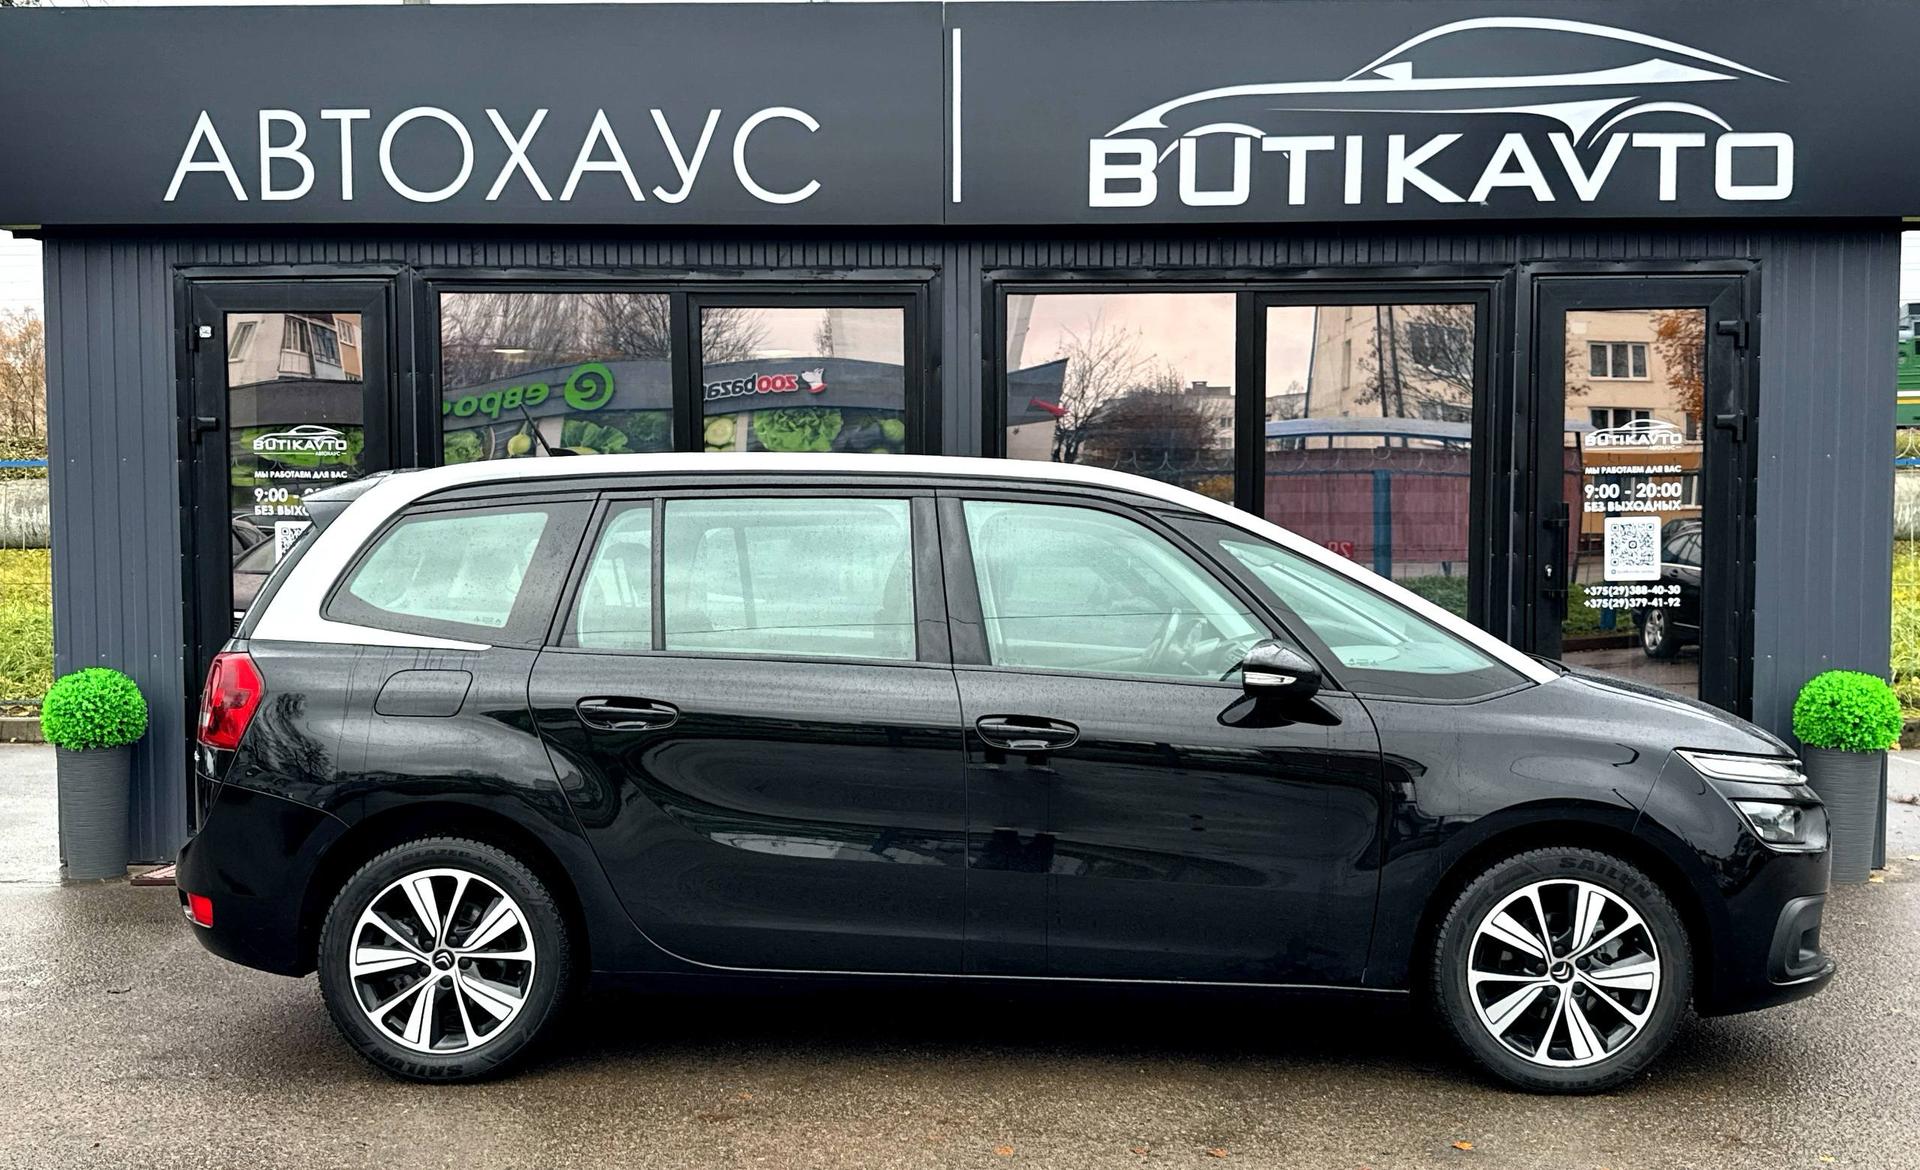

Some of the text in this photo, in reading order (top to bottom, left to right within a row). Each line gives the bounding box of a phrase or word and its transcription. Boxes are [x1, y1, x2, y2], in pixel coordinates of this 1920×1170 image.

[164, 106, 821, 204] АВТОХАУС
[1088, 131, 1794, 207] BUTIKAVTO
[253, 439, 347, 451] BUTIKAVTO
[1584, 433, 1682, 446] BUTIKAVTO
[254, 471, 348, 479] МЫ РАБОТАЕМ ДЛЯ ВАС
[1585, 465, 1682, 475] МЫ РАБОТАЕМ ДЛЯ ВАС
[254, 488, 288, 502] 9:00
[1584, 484, 1620, 499] 9:00
[1636, 483, 1682, 498] 20:00
[254, 506, 275, 516] БЕЗ
[1584, 500, 1681, 512] БЕЗ ВЫХОДНЫХ
